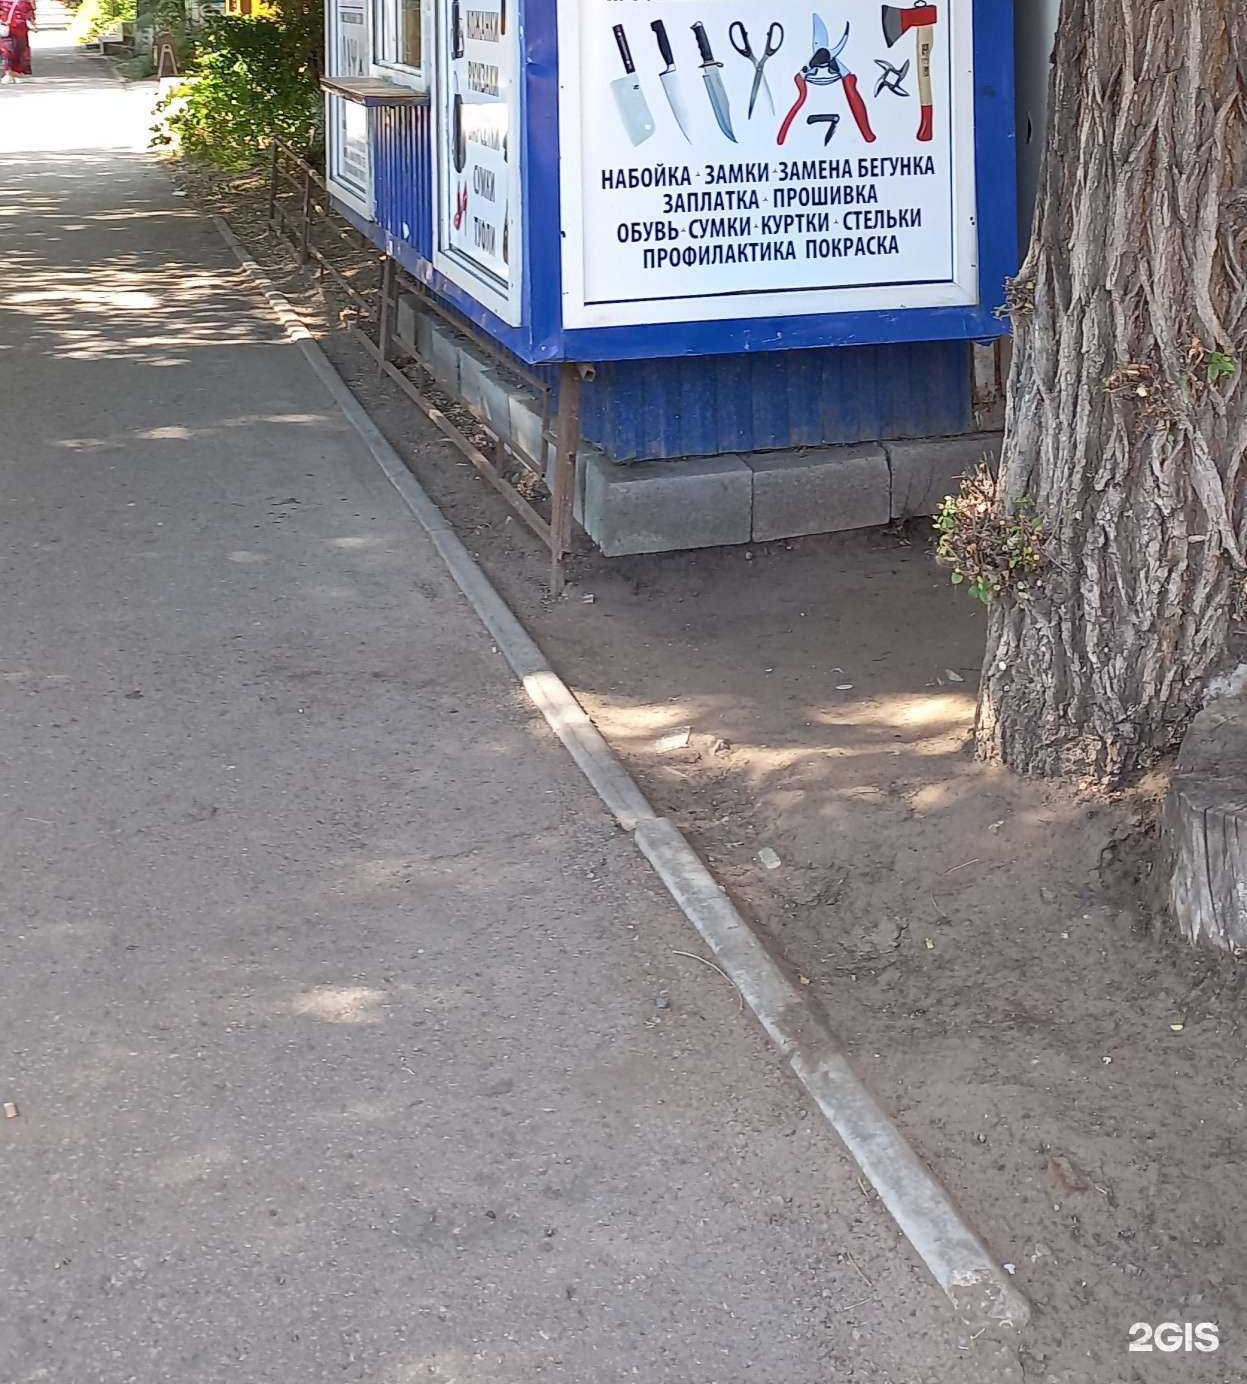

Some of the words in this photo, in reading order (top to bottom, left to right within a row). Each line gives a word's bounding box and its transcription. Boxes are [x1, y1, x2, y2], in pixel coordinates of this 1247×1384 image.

[601, 163, 691, 189] НАБОЙКА
[704, 162, 769, 184] ЗАМКИ
[778, 159, 852, 182] ЗАМЕНА
[858, 156, 935, 178] БЕГУНКА
[663, 188, 760, 213] ЗАПЛАТКА
[773, 184, 878, 208] ПРОШИВКА
[617, 220, 679, 244] ОБУВЬ
[689, 216, 751, 239] СУМКИ
[761, 213, 829, 237] КУРТКИ
[843, 209, 922, 231] СТЕЛЬКИ
[643, 241, 796, 269] ПРОФИЛАКТИКА
[806, 236, 899, 259] ПОКРАСКА
